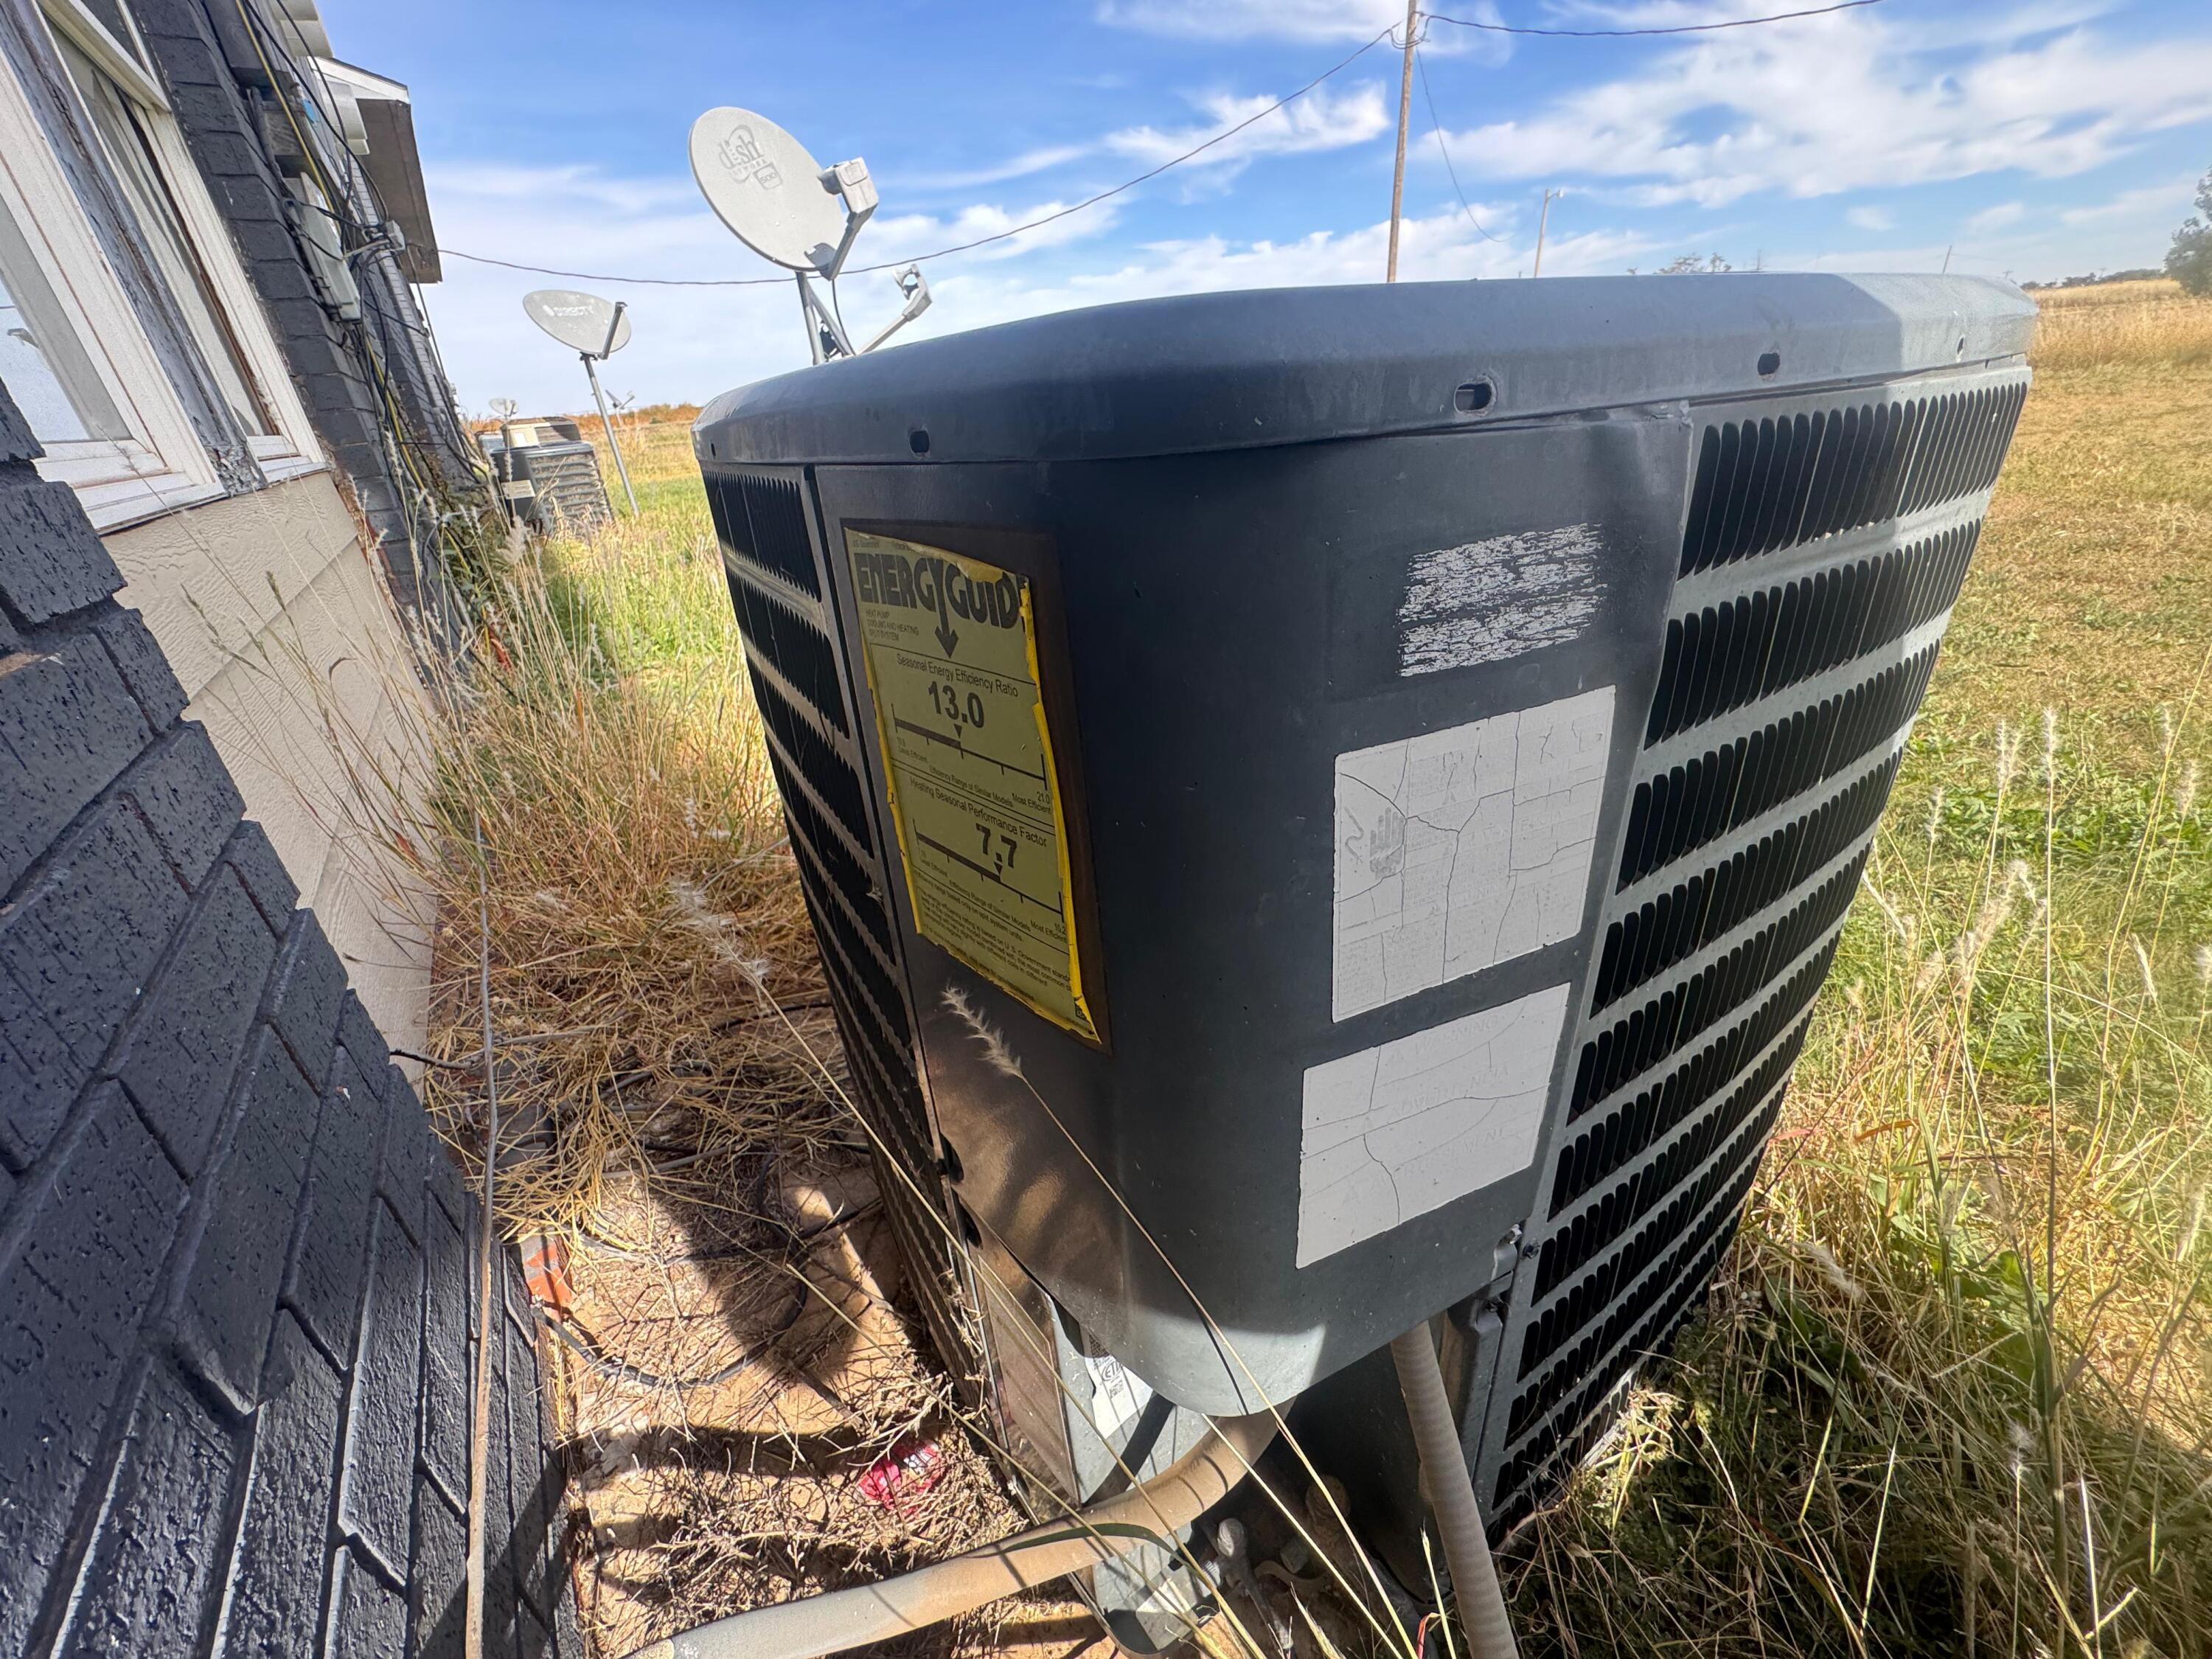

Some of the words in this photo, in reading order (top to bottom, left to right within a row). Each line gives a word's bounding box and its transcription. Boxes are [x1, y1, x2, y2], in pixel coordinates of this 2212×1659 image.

[760, 172, 776, 183] 500
[897, 623, 919, 635] HEATING
[897, 654, 927, 671] Seasonal
[928, 662, 953, 681] Energy
[955, 669, 993, 692] Efficiency
[995, 680, 1018, 696] Ratio
[928, 681, 984, 728] 13.0
[910, 777, 934, 797] Heating
[935, 788, 966, 810] Seasonal
[968, 804, 1017, 834] Performance
[1019, 826, 1047, 847] Factor
[1011, 792, 1026, 804] Most
[1027, 798, 1051, 815] Efficient
[975, 823, 1018, 869] 7.7
